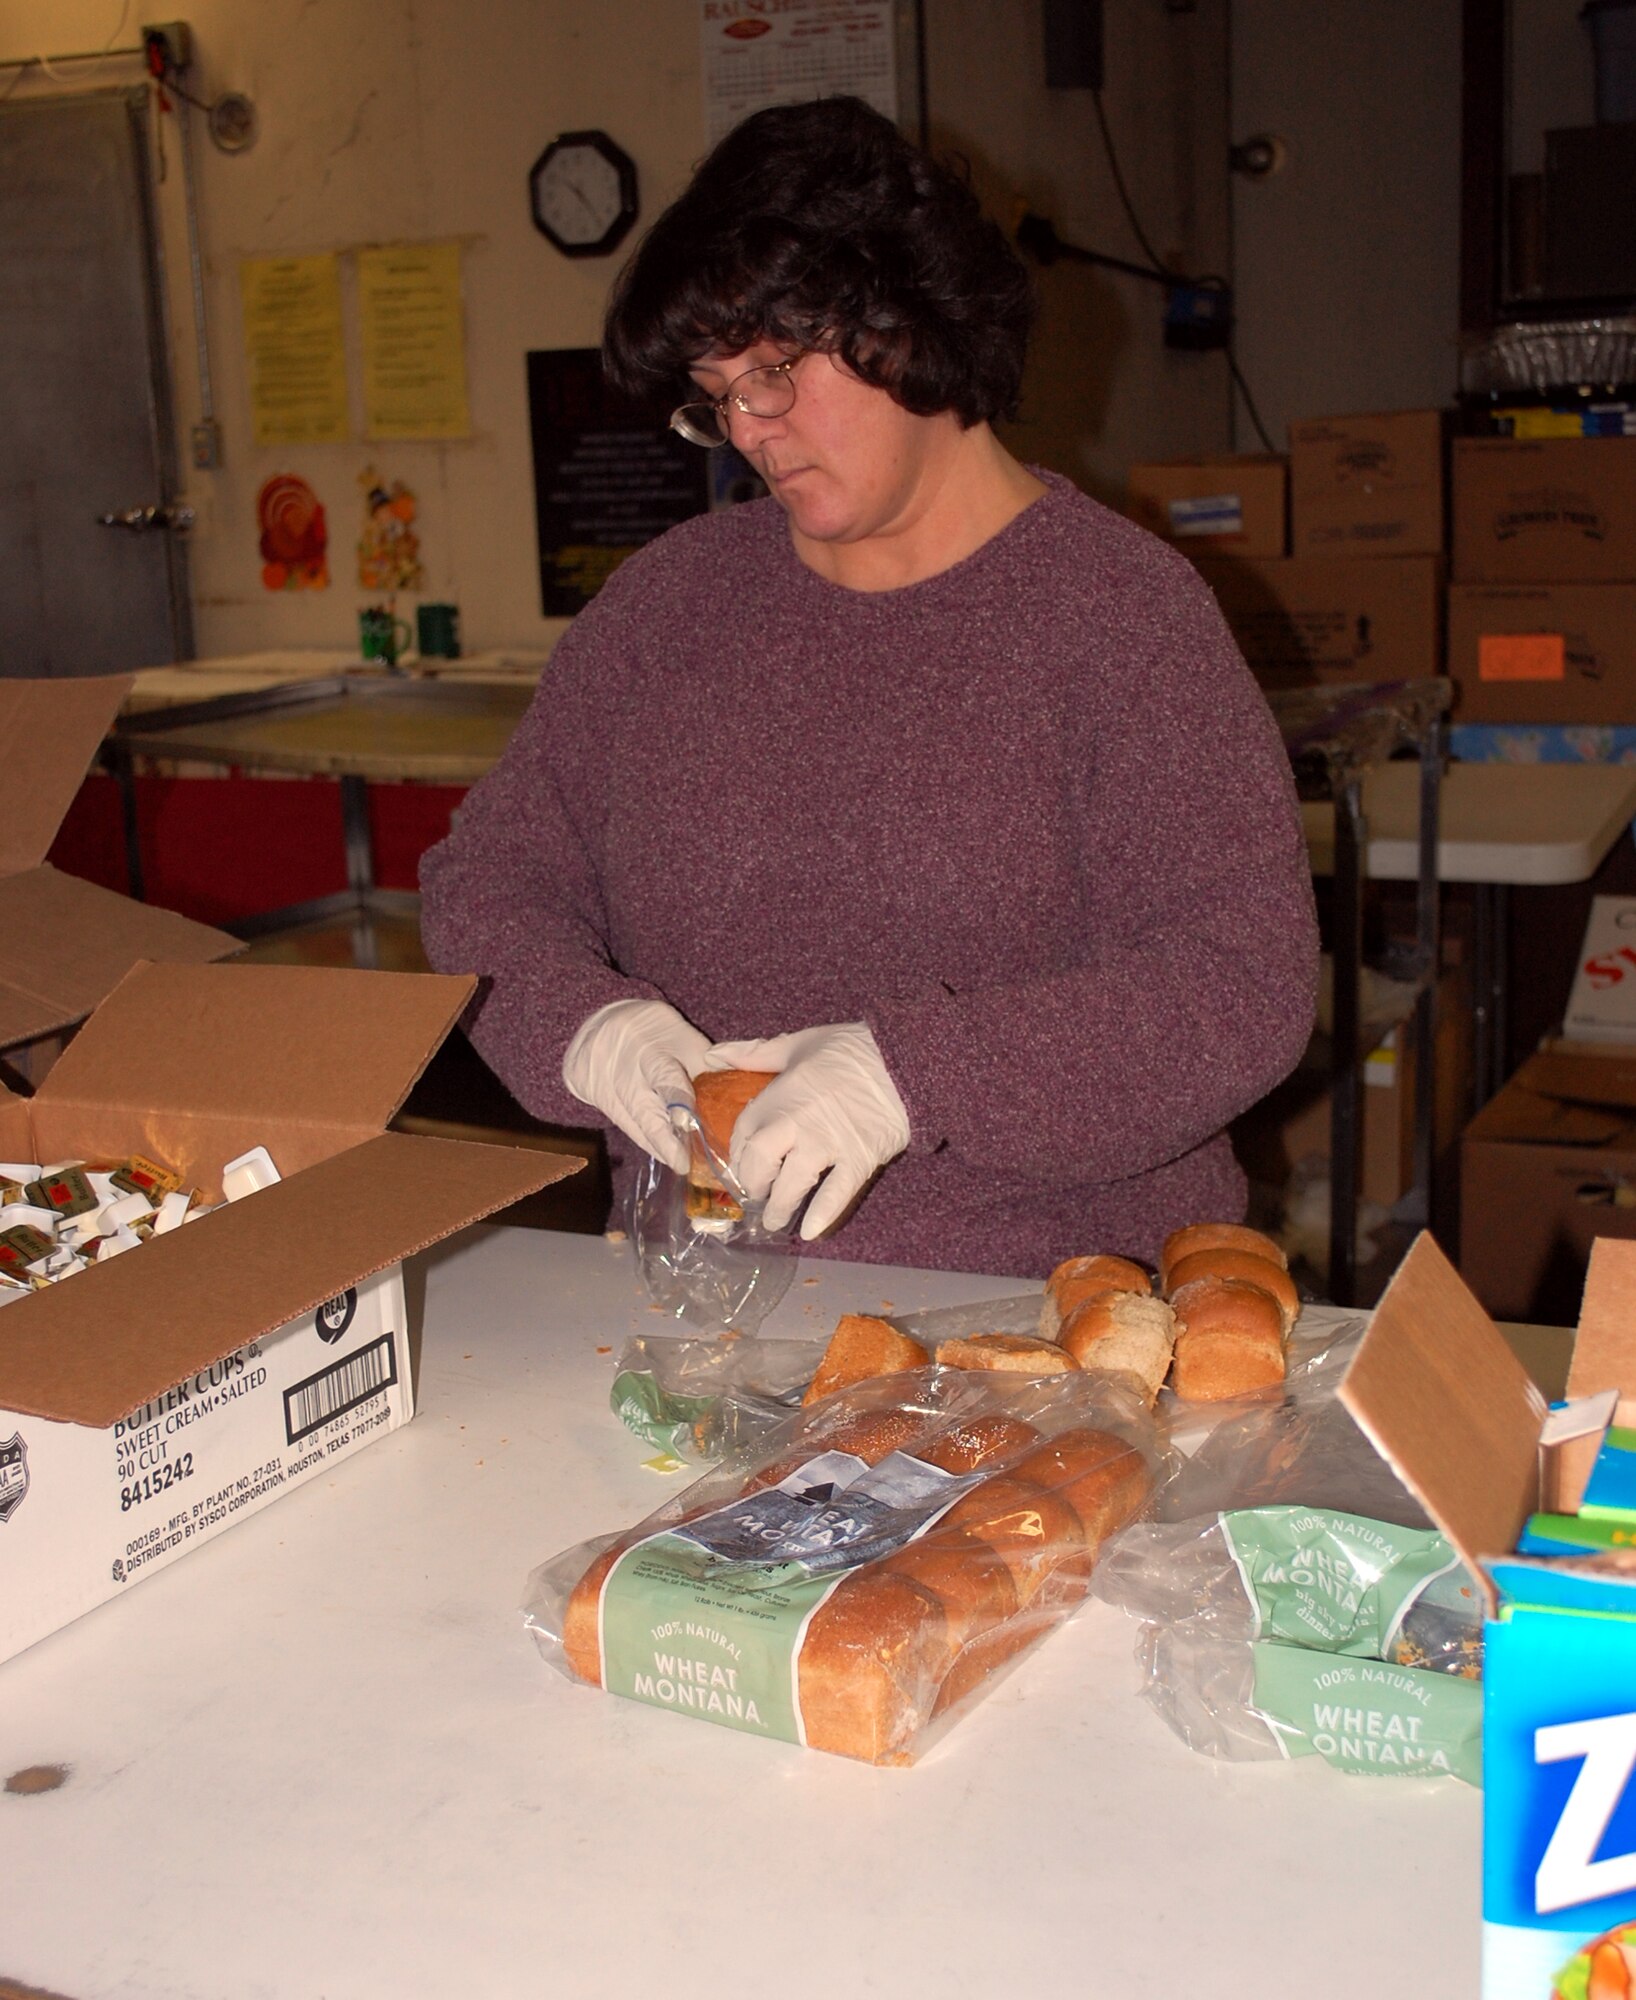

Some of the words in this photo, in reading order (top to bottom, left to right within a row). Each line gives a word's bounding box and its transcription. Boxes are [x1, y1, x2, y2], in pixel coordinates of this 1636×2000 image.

[324, 1293, 346, 1319] REAL
[195, 1350, 244, 1395] CUPS
[116, 1423, 160, 1462] SWEET
[118, 1460, 135, 1482] 90
[139, 1440, 168, 1470] CUT
[120, 1452, 194, 1512] 8415242
[127, 1531, 183, 1572] DISTRIBUTED
[185, 1521, 196, 1538] BY
[199, 1505, 226, 1530] SYSCO
[229, 1471, 286, 1513] CORPORATION,
[287, 1449, 326, 1477] HOUSTON,
[327, 1431, 350, 1455] TEXAS
[126, 1528, 160, 1556] 000169
[168, 1511, 191, 1532] MFG.
[192, 1503, 204, 1518] BY
[206, 1484, 234, 1510] PLANT
[237, 1476, 251, 1493] NO.
[253, 1458, 282, 1482] 27-031
[1290, 1515, 1326, 1533] 100%
[1332, 1519, 1401, 1564] NATURAL
[1292, 1546, 1372, 1592] WHEA
[651, 1621, 683, 1641] 100%
[686, 1622, 742, 1661] NATURAL
[654, 1651, 737, 1692] WHEAT
[1313, 1668, 1356, 1690] 100%
[1362, 1668, 1433, 1706] NATURAL
[633, 1672, 763, 1726] MONTANA
[1313, 1703, 1422, 1743] WHEAT
[1312, 1733, 1450, 1770] ONTANA
